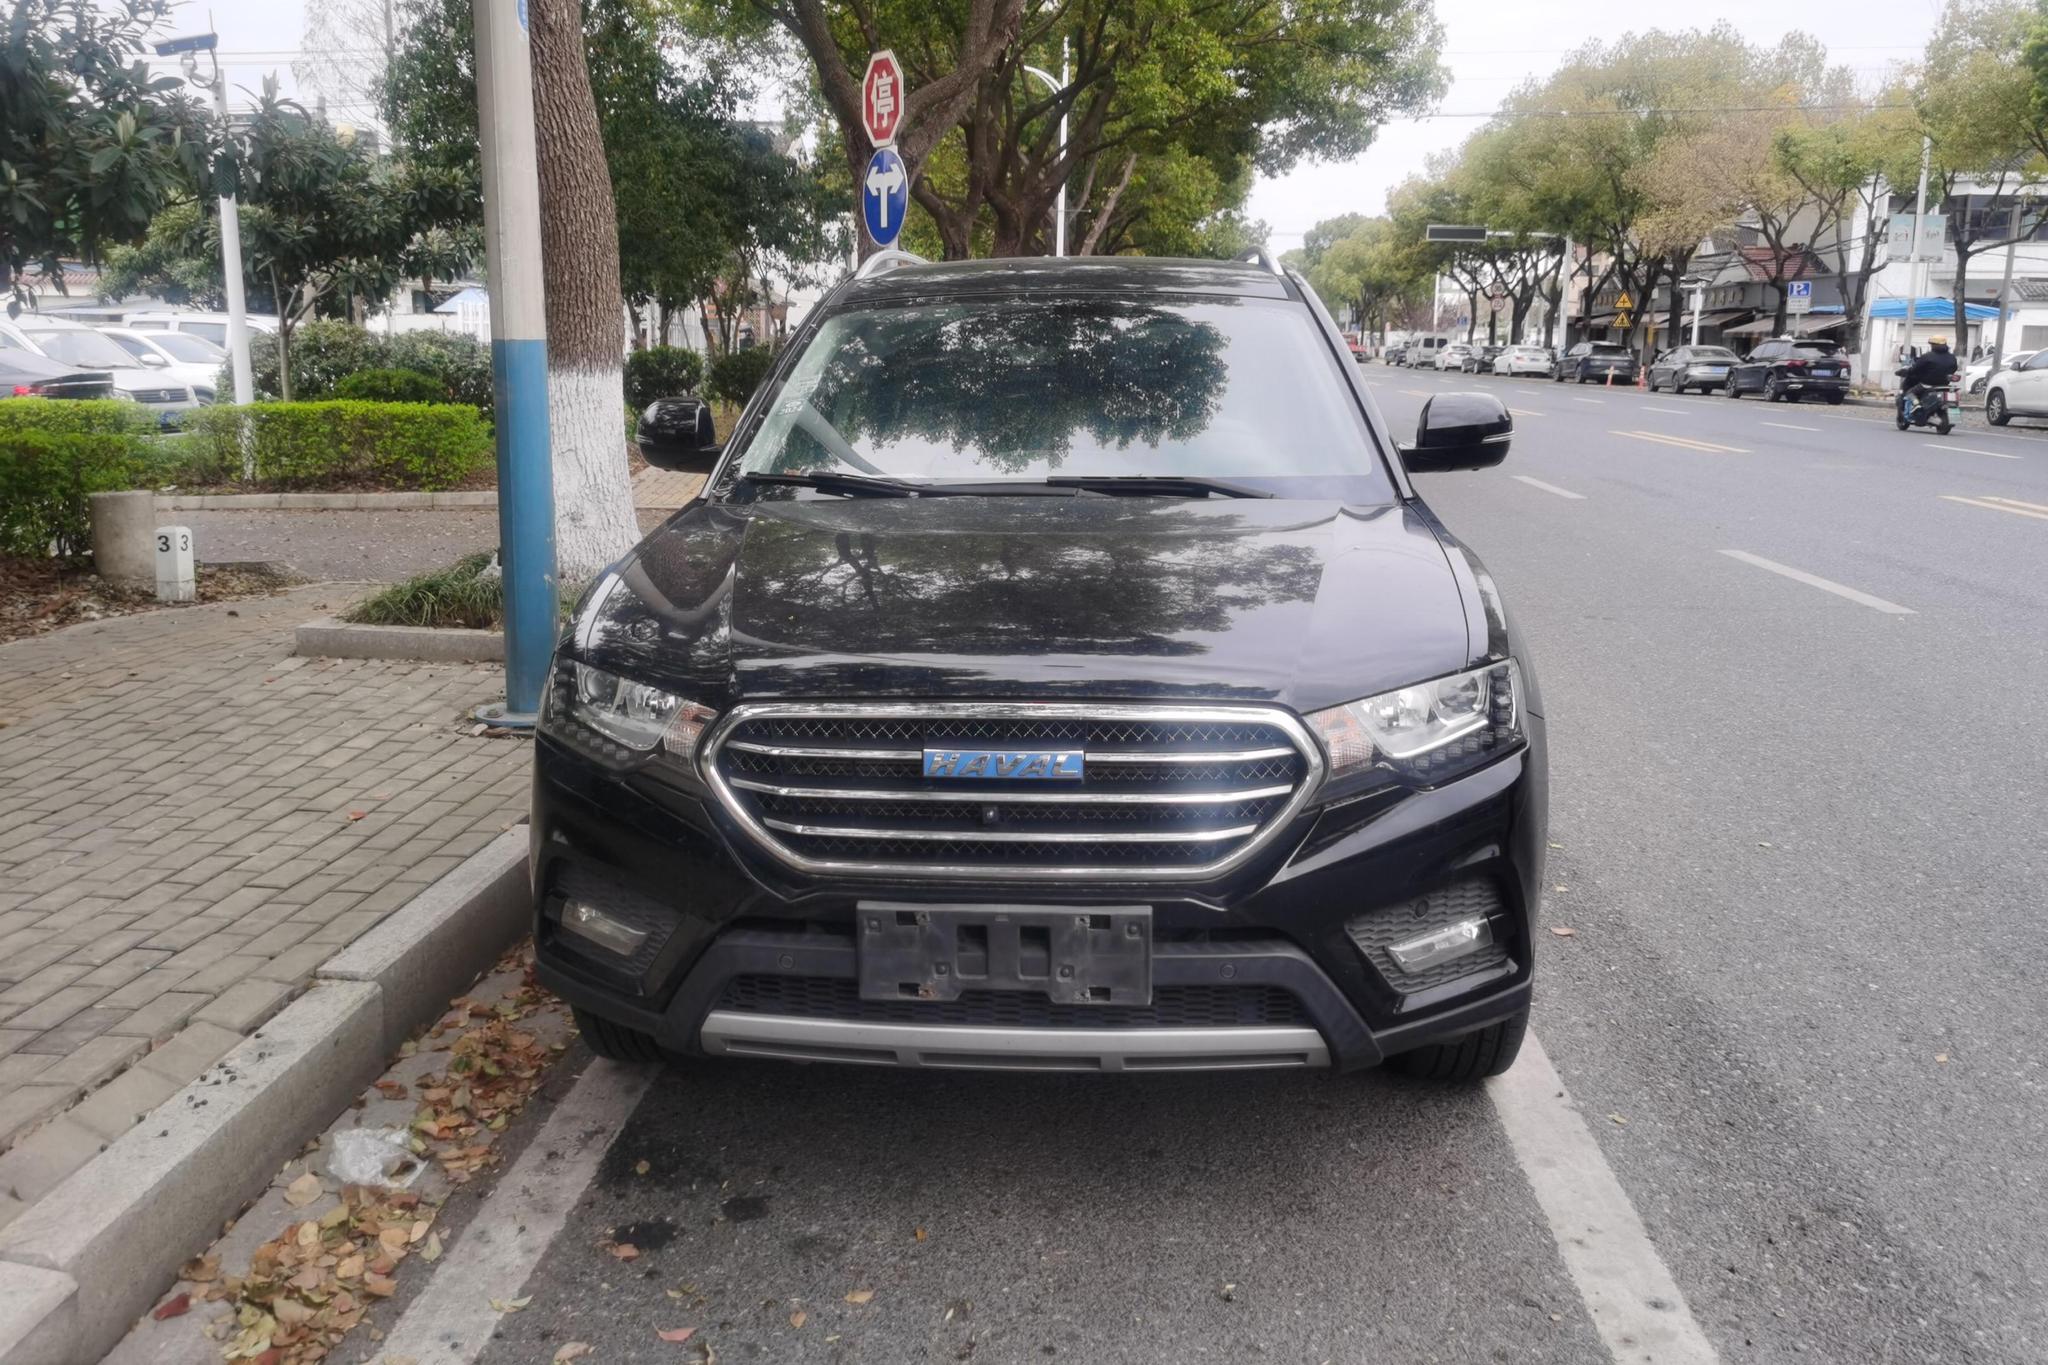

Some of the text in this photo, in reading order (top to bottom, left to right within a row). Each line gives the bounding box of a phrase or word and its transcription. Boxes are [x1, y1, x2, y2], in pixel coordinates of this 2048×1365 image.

[870, 70, 895, 129] 停
[1792, 283, 1805, 296] P
[157, 535, 171, 553] 3
[180, 534, 189, 552] 3
[928, 752, 1079, 778] HAVAL
